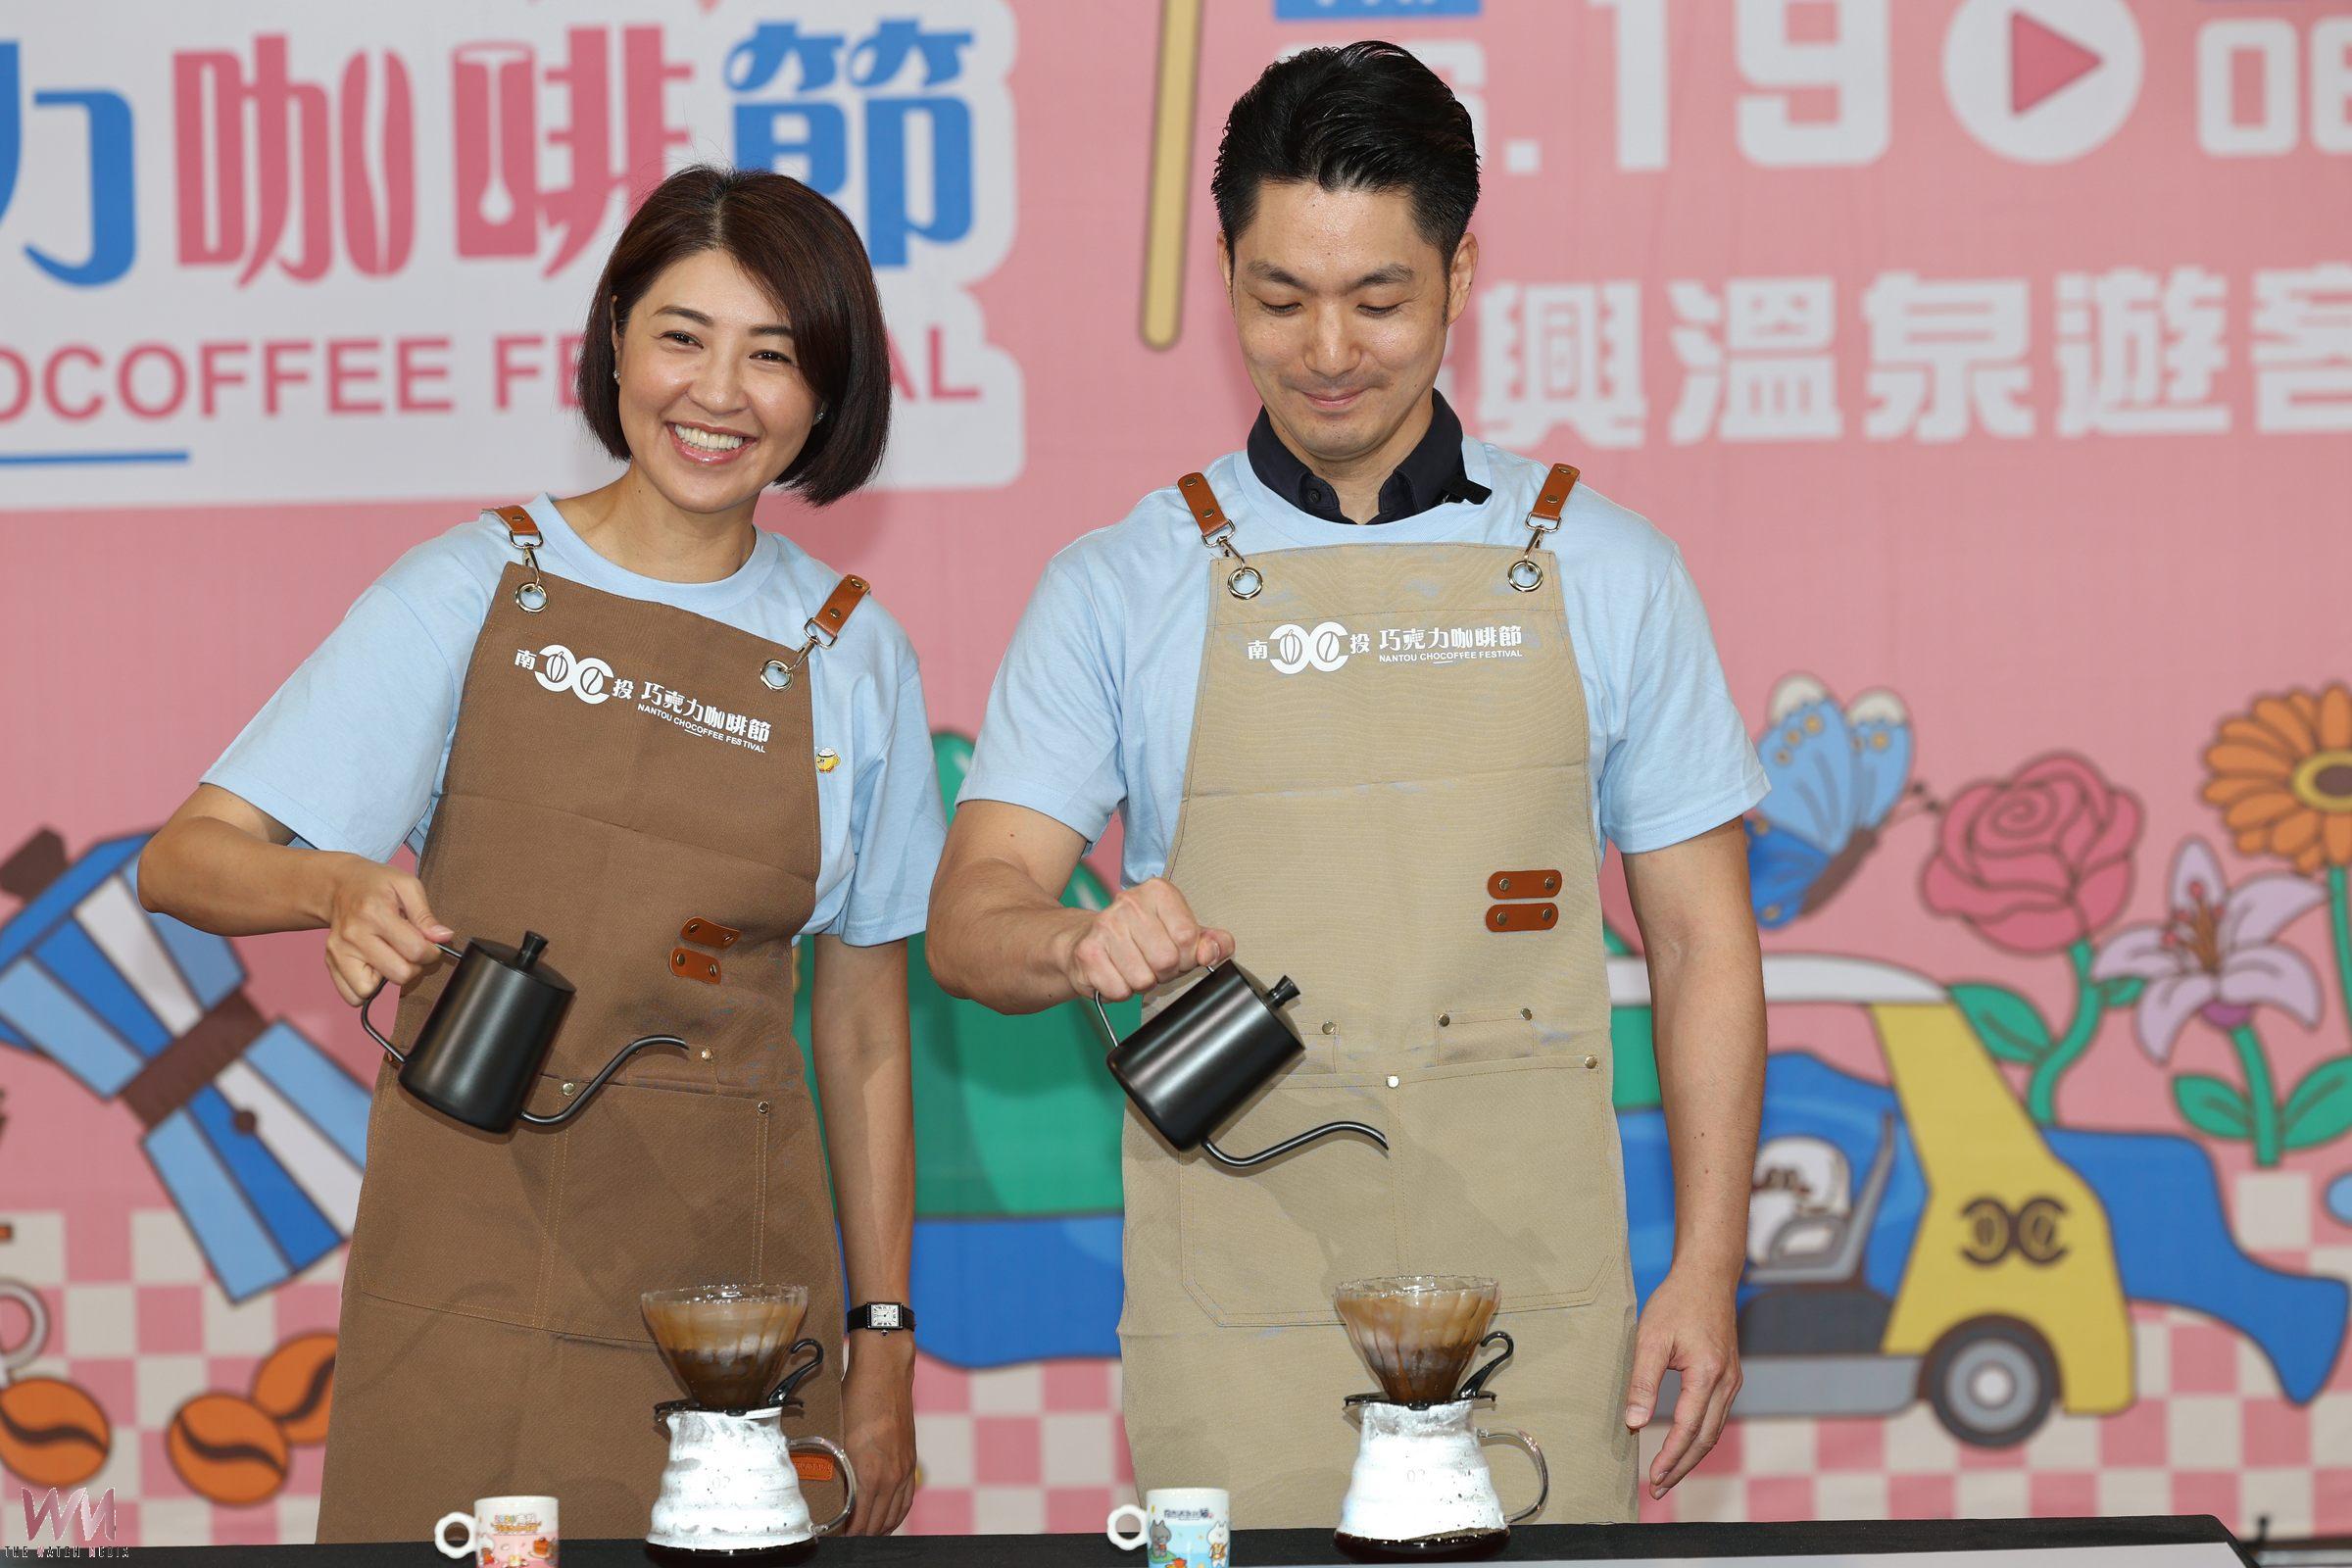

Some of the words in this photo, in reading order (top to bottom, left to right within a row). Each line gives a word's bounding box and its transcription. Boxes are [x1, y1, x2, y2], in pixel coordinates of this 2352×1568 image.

[1435, 263, 2352, 451] 興溫泉遊客
[1248, 639, 1268, 660] 南
[1349, 633, 1370, 654] 投
[1379, 625, 1522, 651] 巧克力咖啡節
[1379, 654, 1417, 662] NANTOU
[1420, 651, 1477, 661] CHOCOFFEE
[1479, 650, 1523, 659] FESTIVAL
[514, 649, 537, 670] 南
[612, 678, 634, 700] 投
[641, 681, 772, 743] 巧克力咖啡節
[637, 704, 673, 721] NANTOU
[673, 716, 724, 741] CHOCOFFEE
[725, 735, 766, 754] FESTIVAL
